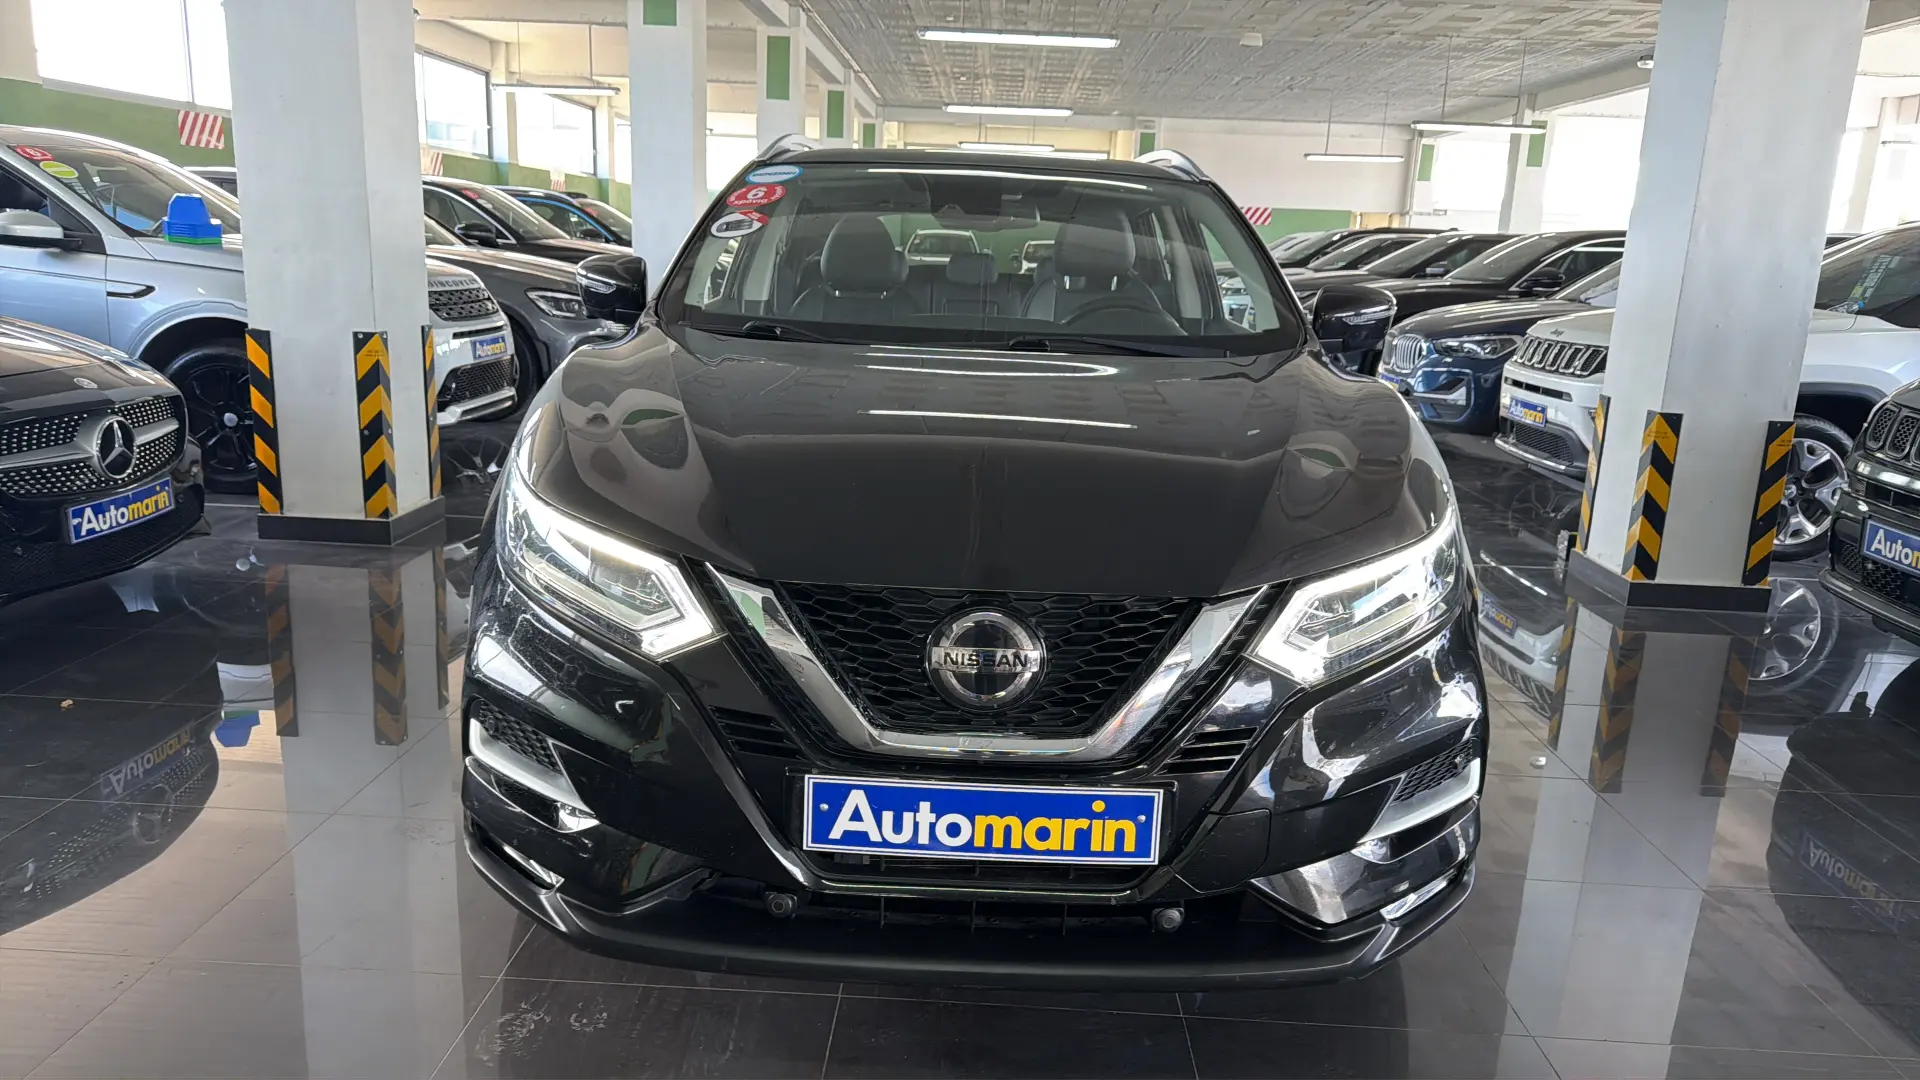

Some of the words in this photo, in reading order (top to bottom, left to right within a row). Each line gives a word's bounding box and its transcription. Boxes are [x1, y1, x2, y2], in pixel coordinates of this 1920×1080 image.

[746, 186, 768, 199] 6
[80, 485, 169, 536] Automarin
[943, 651, 1028, 668] NISSAN
[828, 789, 1137, 852] Automarin
